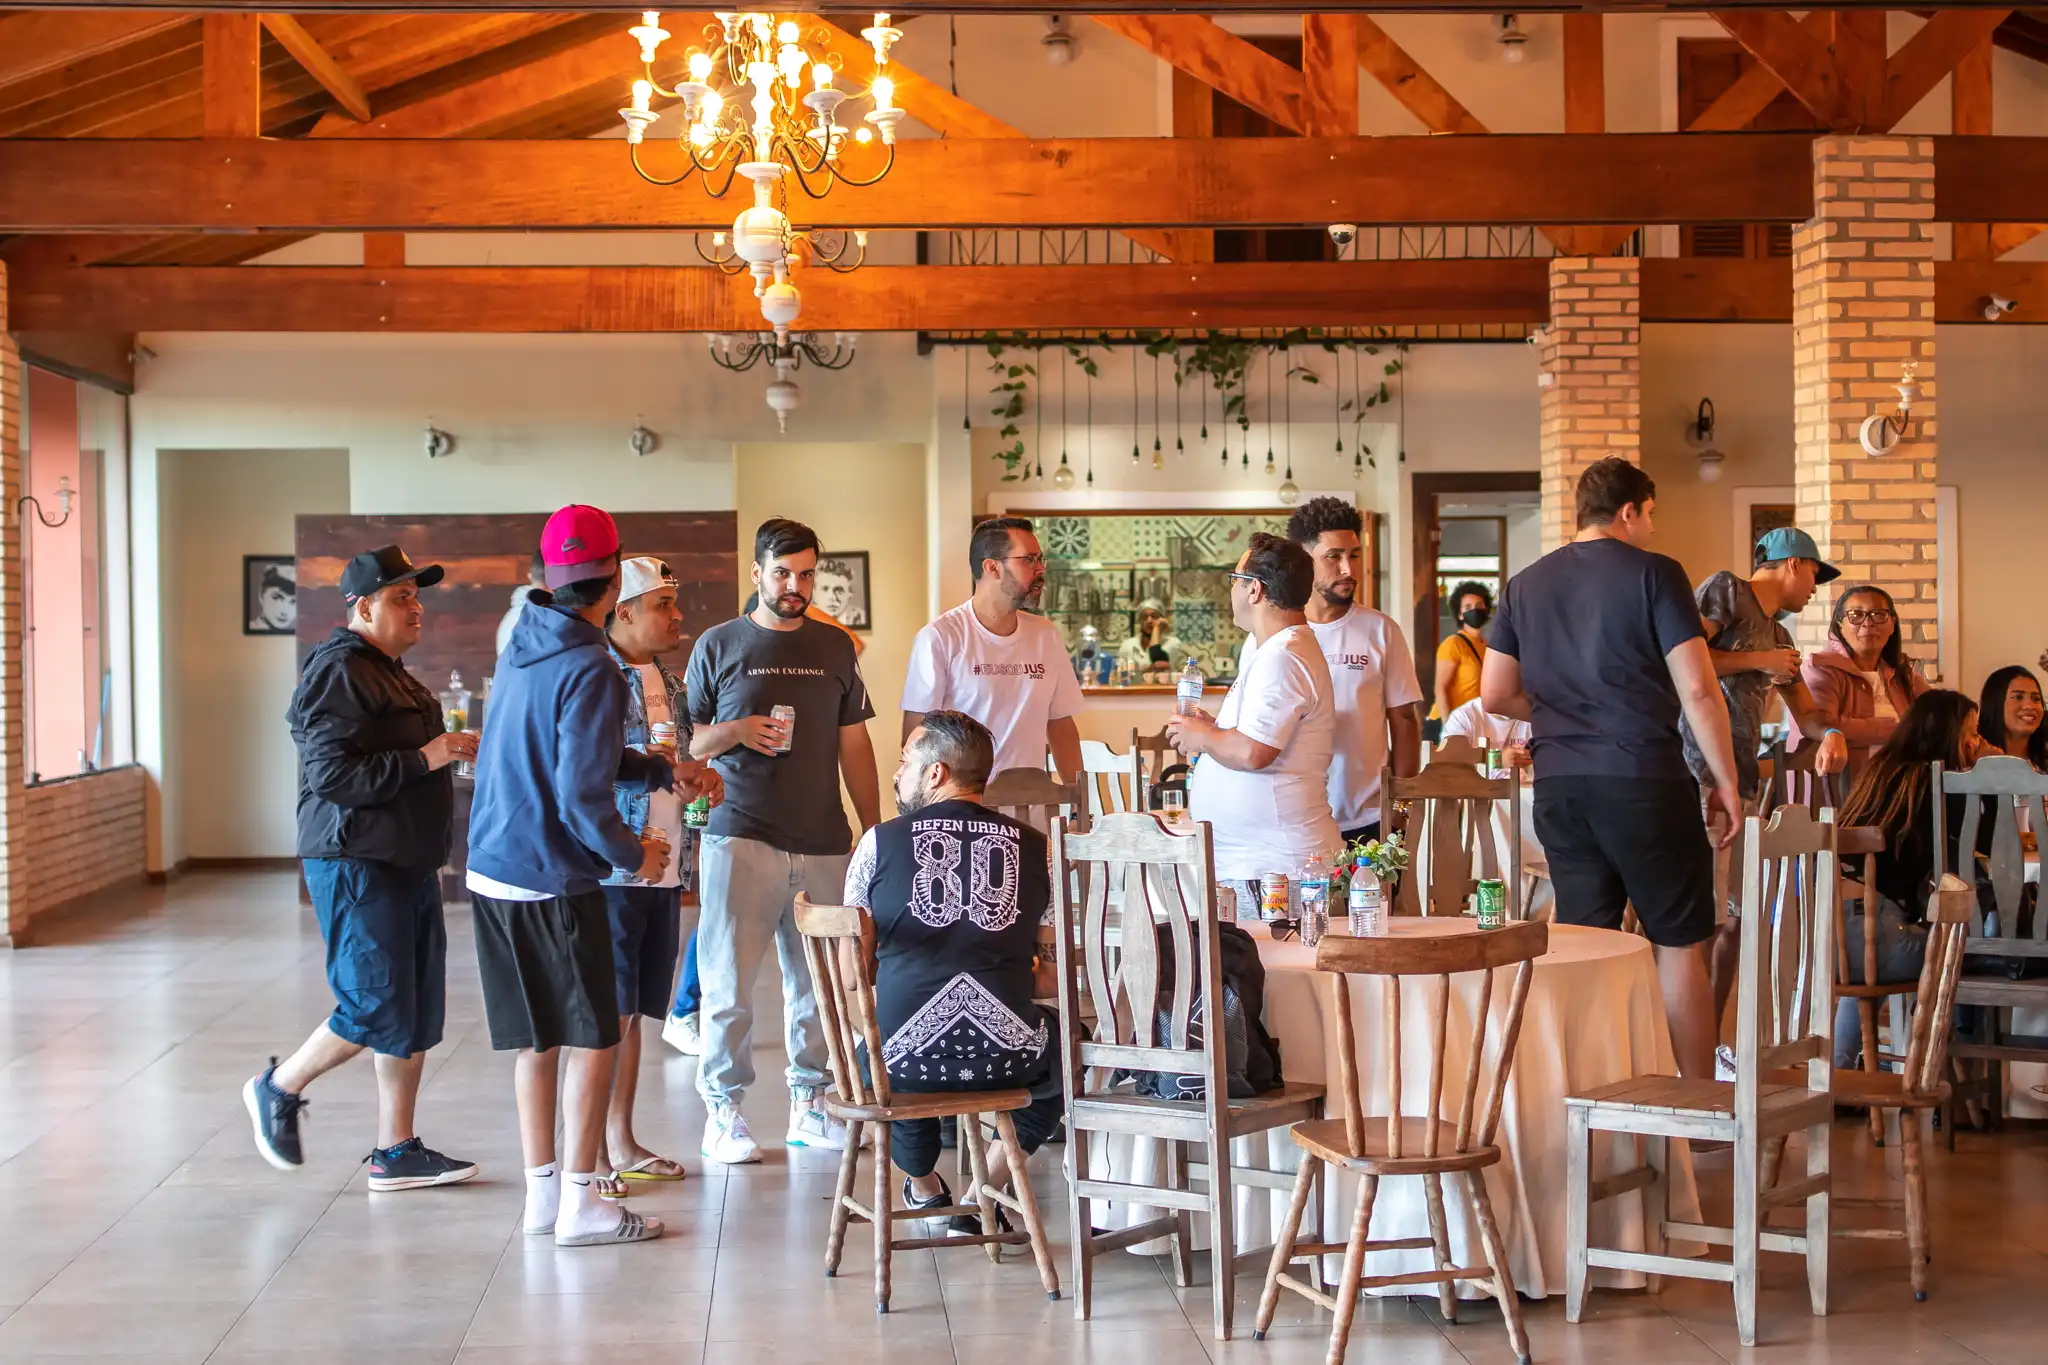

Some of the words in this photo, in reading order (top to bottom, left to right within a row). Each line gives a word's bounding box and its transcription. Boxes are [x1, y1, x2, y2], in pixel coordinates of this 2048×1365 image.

[747, 667, 780, 676] ARMANI
[782, 667, 825, 676] EXCHANGE
[967, 820, 1020, 840] URBAN
